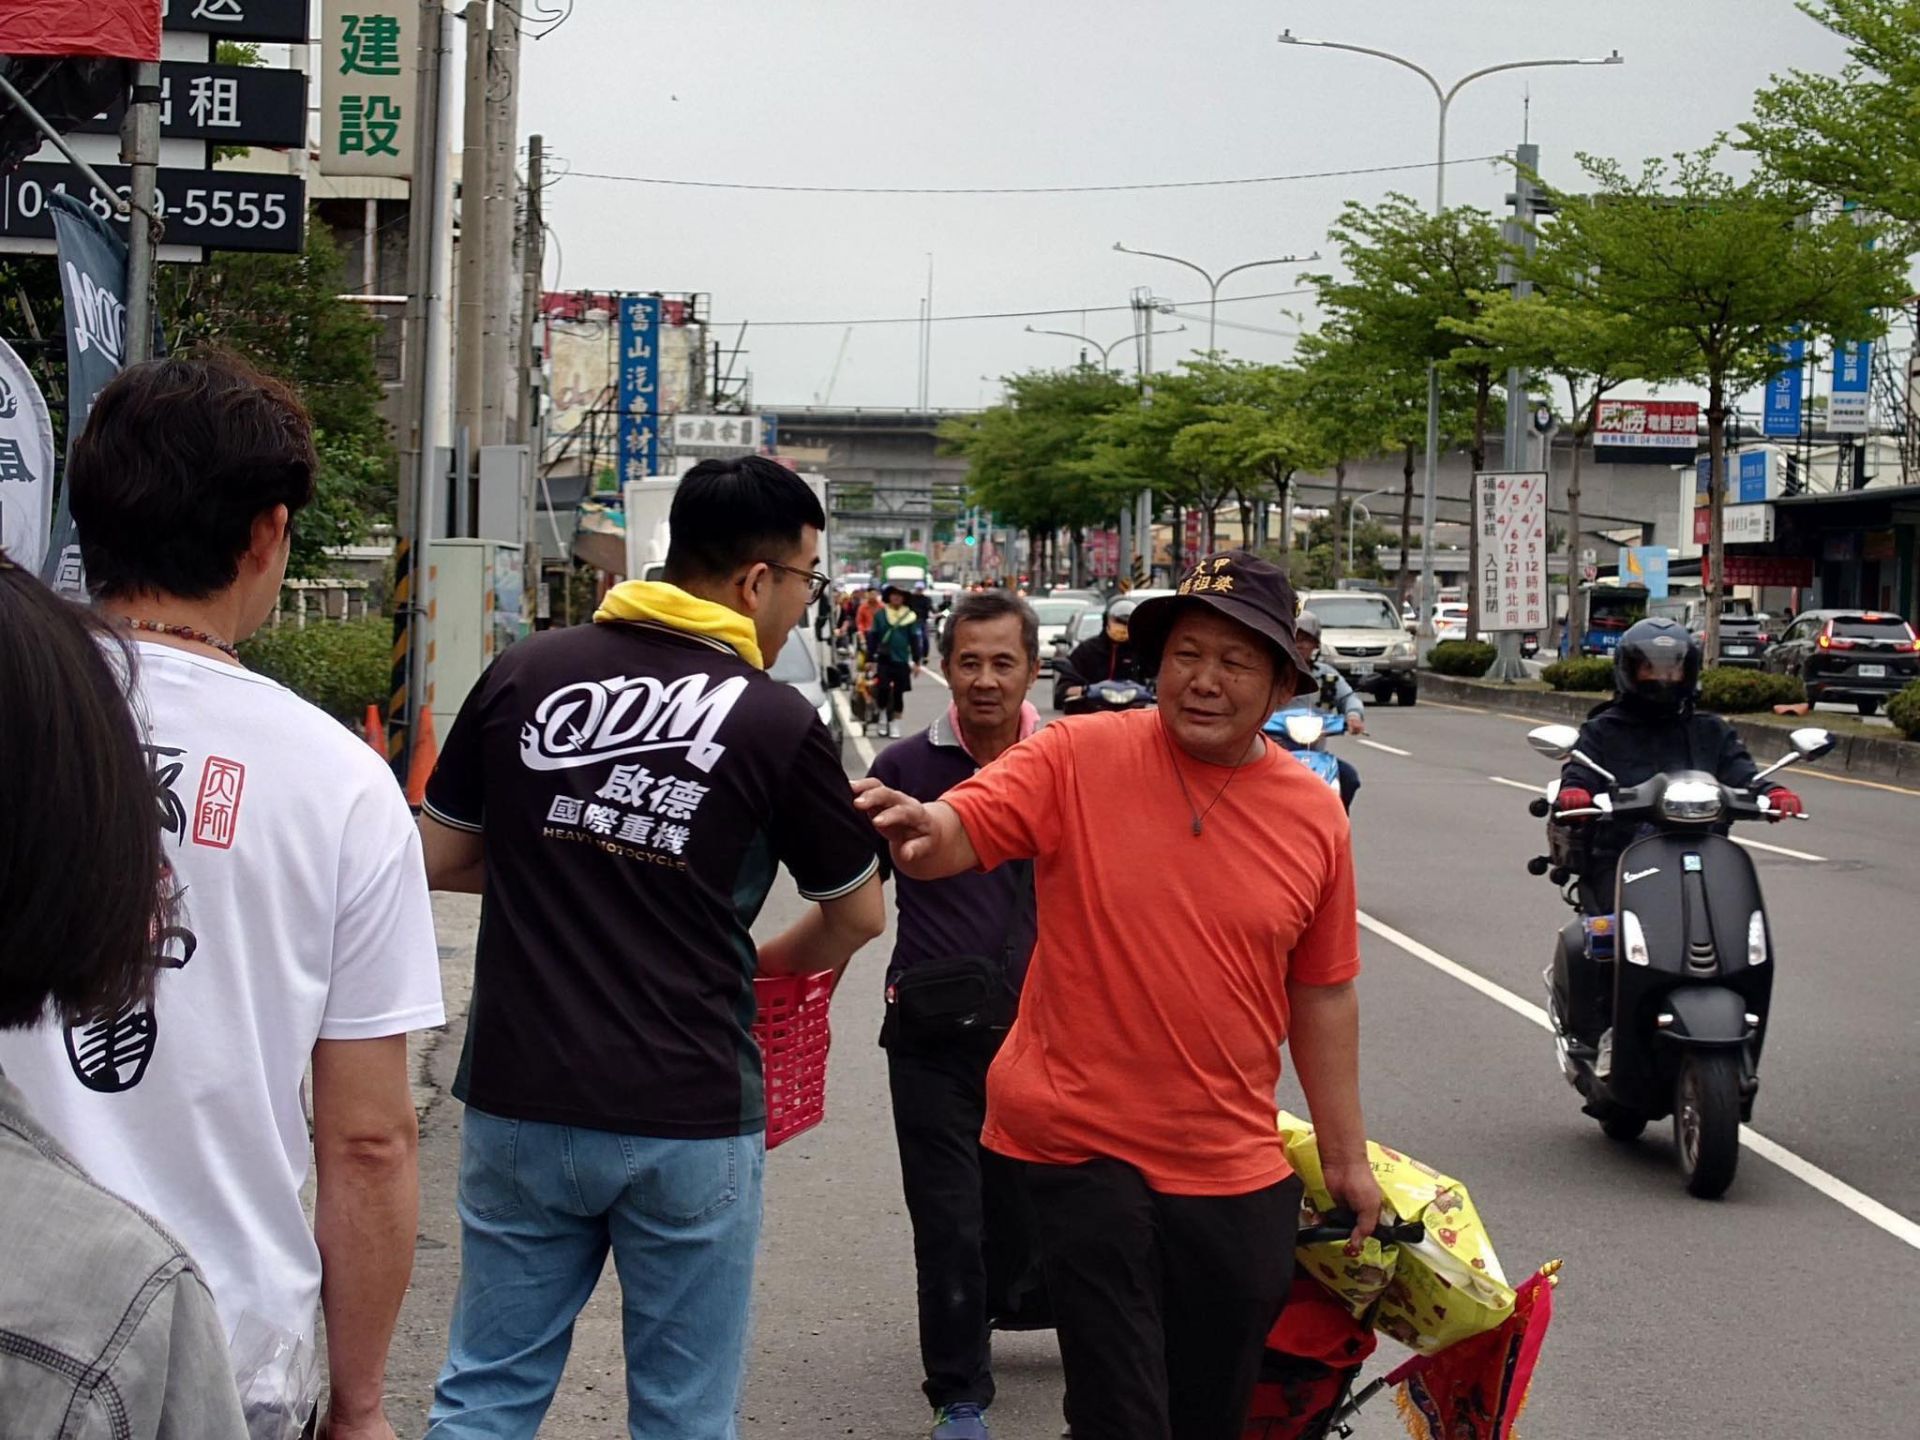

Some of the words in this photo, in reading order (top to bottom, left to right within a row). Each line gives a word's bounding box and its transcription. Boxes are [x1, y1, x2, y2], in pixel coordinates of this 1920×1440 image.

[339, 14, 402, 157] 建設
[1485, 553, 1498, 613] 入口封閉
[595, 763, 711, 820] 啟德
[547, 794, 690, 855] 國際重機
